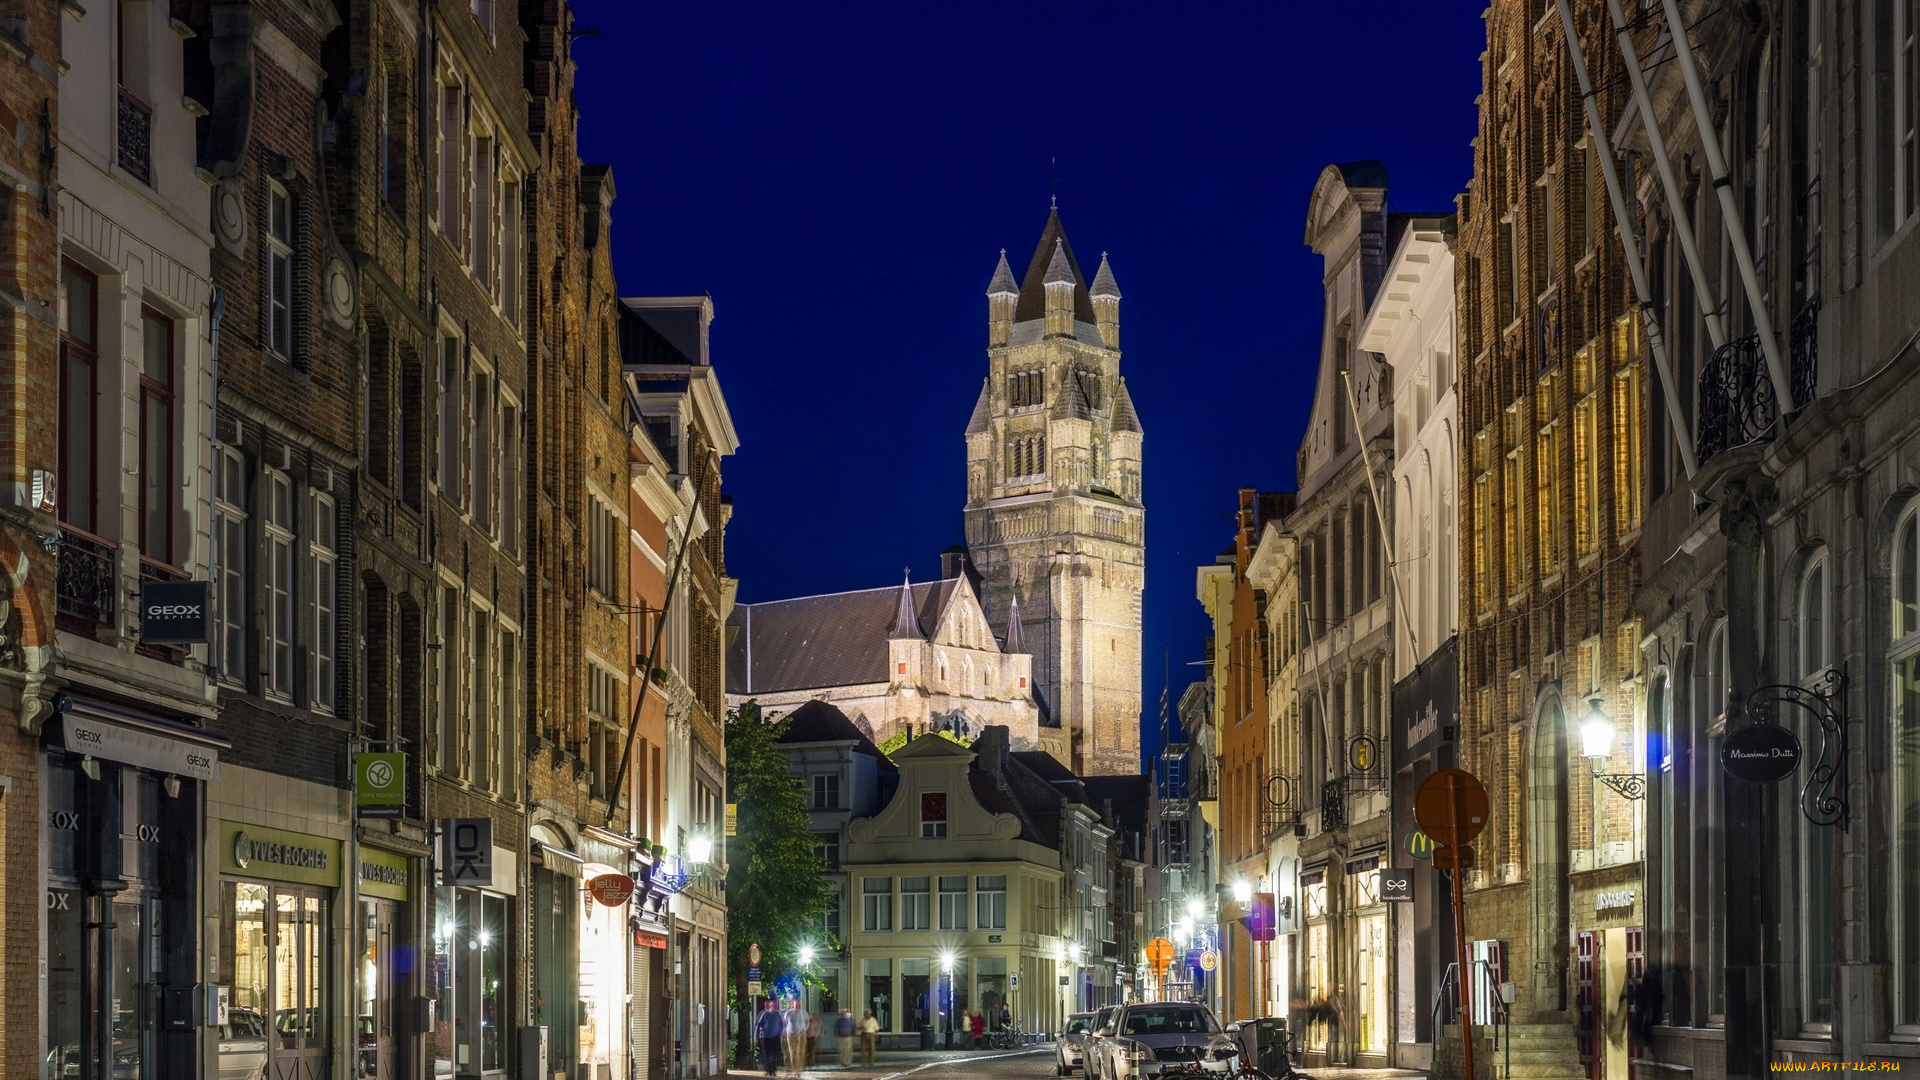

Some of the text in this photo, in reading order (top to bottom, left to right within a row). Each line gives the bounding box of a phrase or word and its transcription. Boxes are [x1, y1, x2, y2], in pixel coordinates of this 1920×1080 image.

[148, 605, 201, 615] GEOX
[75, 728, 102, 744] GEOX
[1730, 747, 1795, 759] Massimo Dutti
[186, 754, 210, 769] GEOX
[253, 841, 328, 869] YVES ROCHER
[363, 862, 408, 887] YVES ROCHER
[593, 879, 621, 891] jelly
[602, 889, 629, 902] jazz
